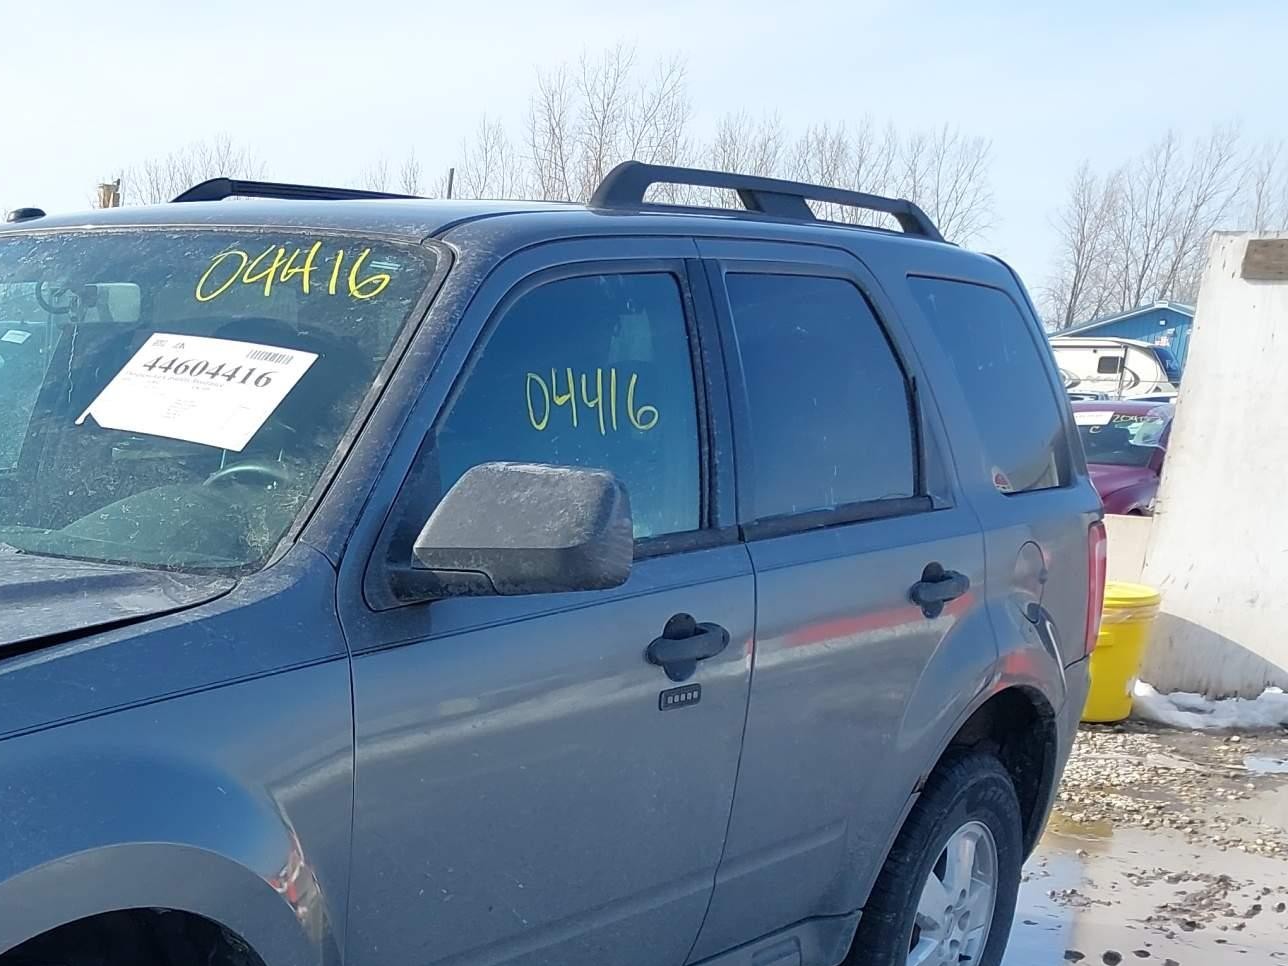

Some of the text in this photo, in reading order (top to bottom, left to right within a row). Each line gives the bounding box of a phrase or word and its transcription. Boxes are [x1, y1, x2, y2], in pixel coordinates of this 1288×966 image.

[195, 241, 391, 301] 04416
[143, 355, 279, 388] 44604416
[526, 367, 659, 436] 04416
